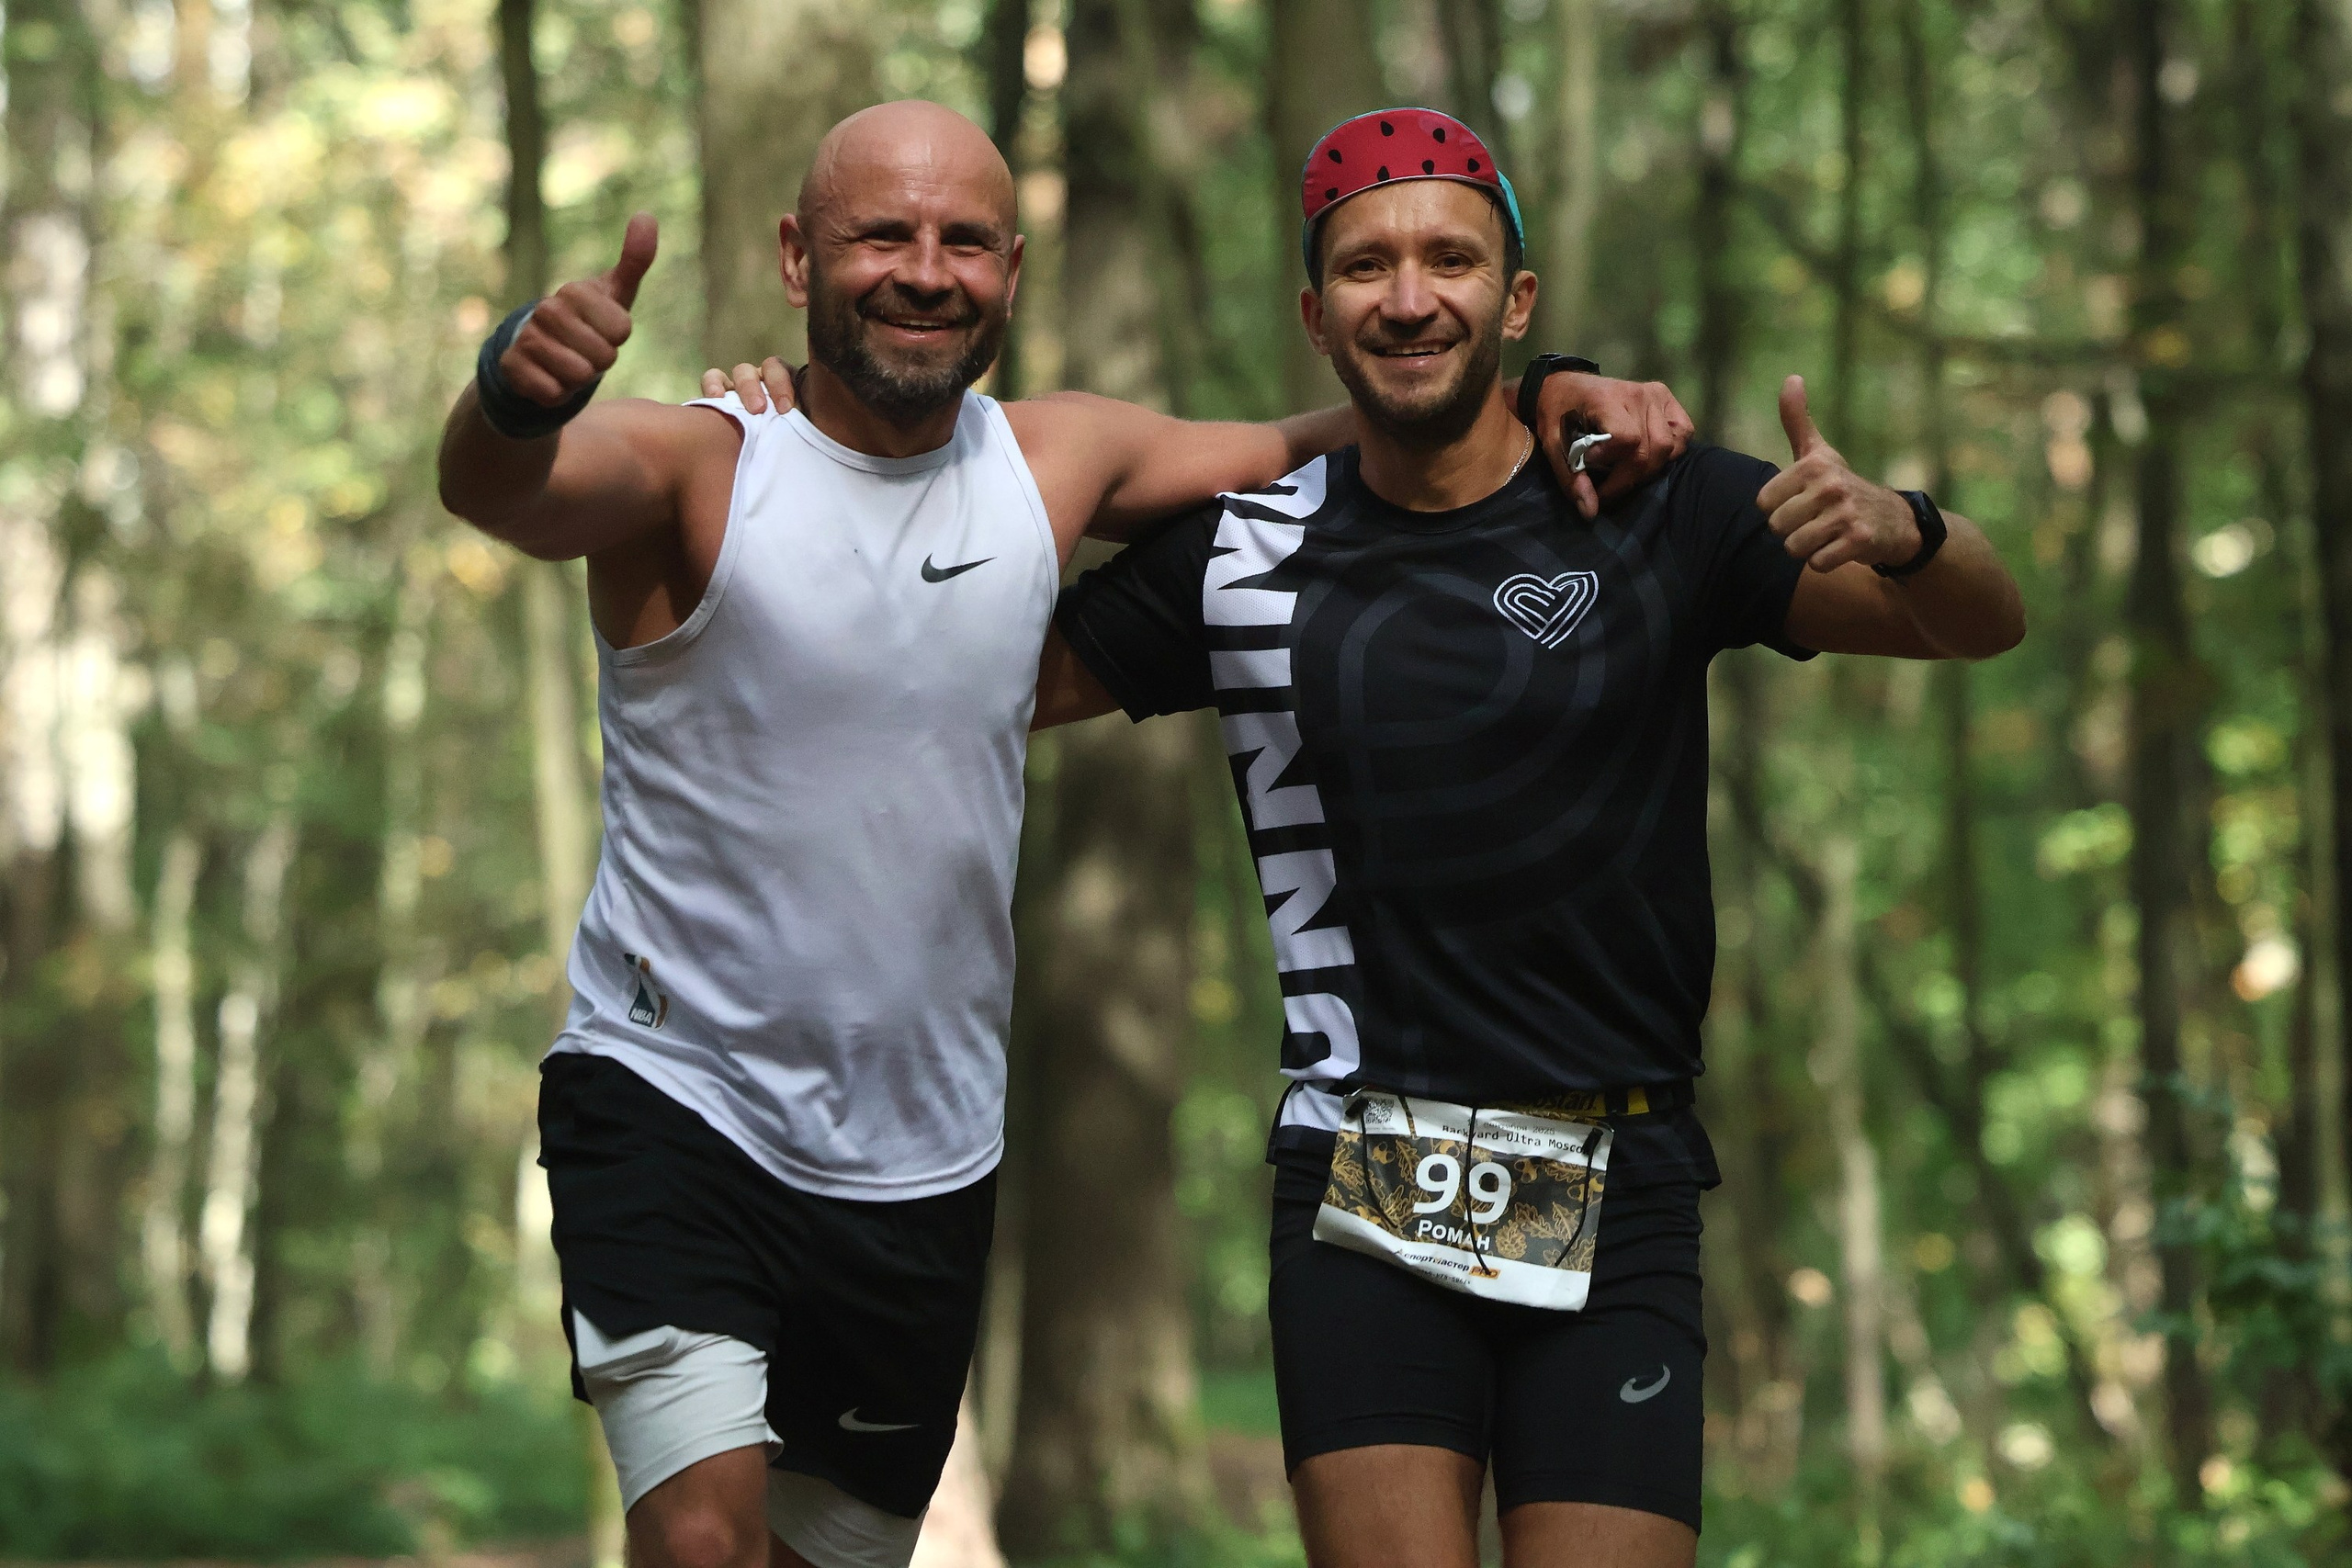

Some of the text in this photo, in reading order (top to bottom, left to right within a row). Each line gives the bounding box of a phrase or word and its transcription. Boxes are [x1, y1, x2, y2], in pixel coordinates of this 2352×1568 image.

[631, 1009, 652, 1023] NBA
[1532, 1125, 1555, 1135] 2025
[1507, 1132, 1541, 1146] Ultra
[1548, 1138, 1584, 1154] Mosco
[1413, 1154, 1511, 1224] 99
